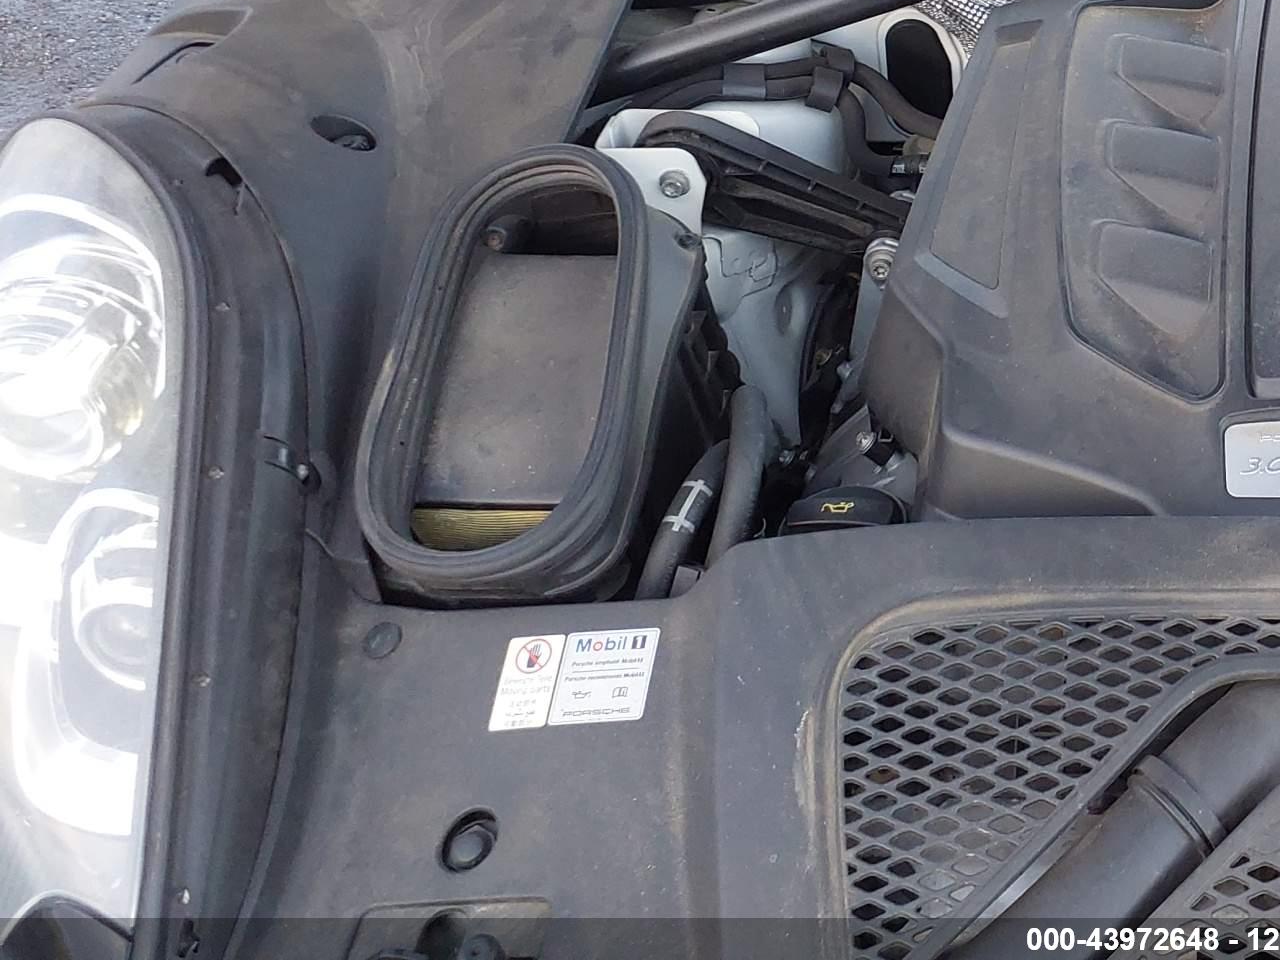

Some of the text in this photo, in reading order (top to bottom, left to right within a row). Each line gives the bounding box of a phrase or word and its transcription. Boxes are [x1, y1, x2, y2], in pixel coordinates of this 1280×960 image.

[575, 635, 648, 653] Mobil 1
[562, 706, 631, 717] PORSCHE
